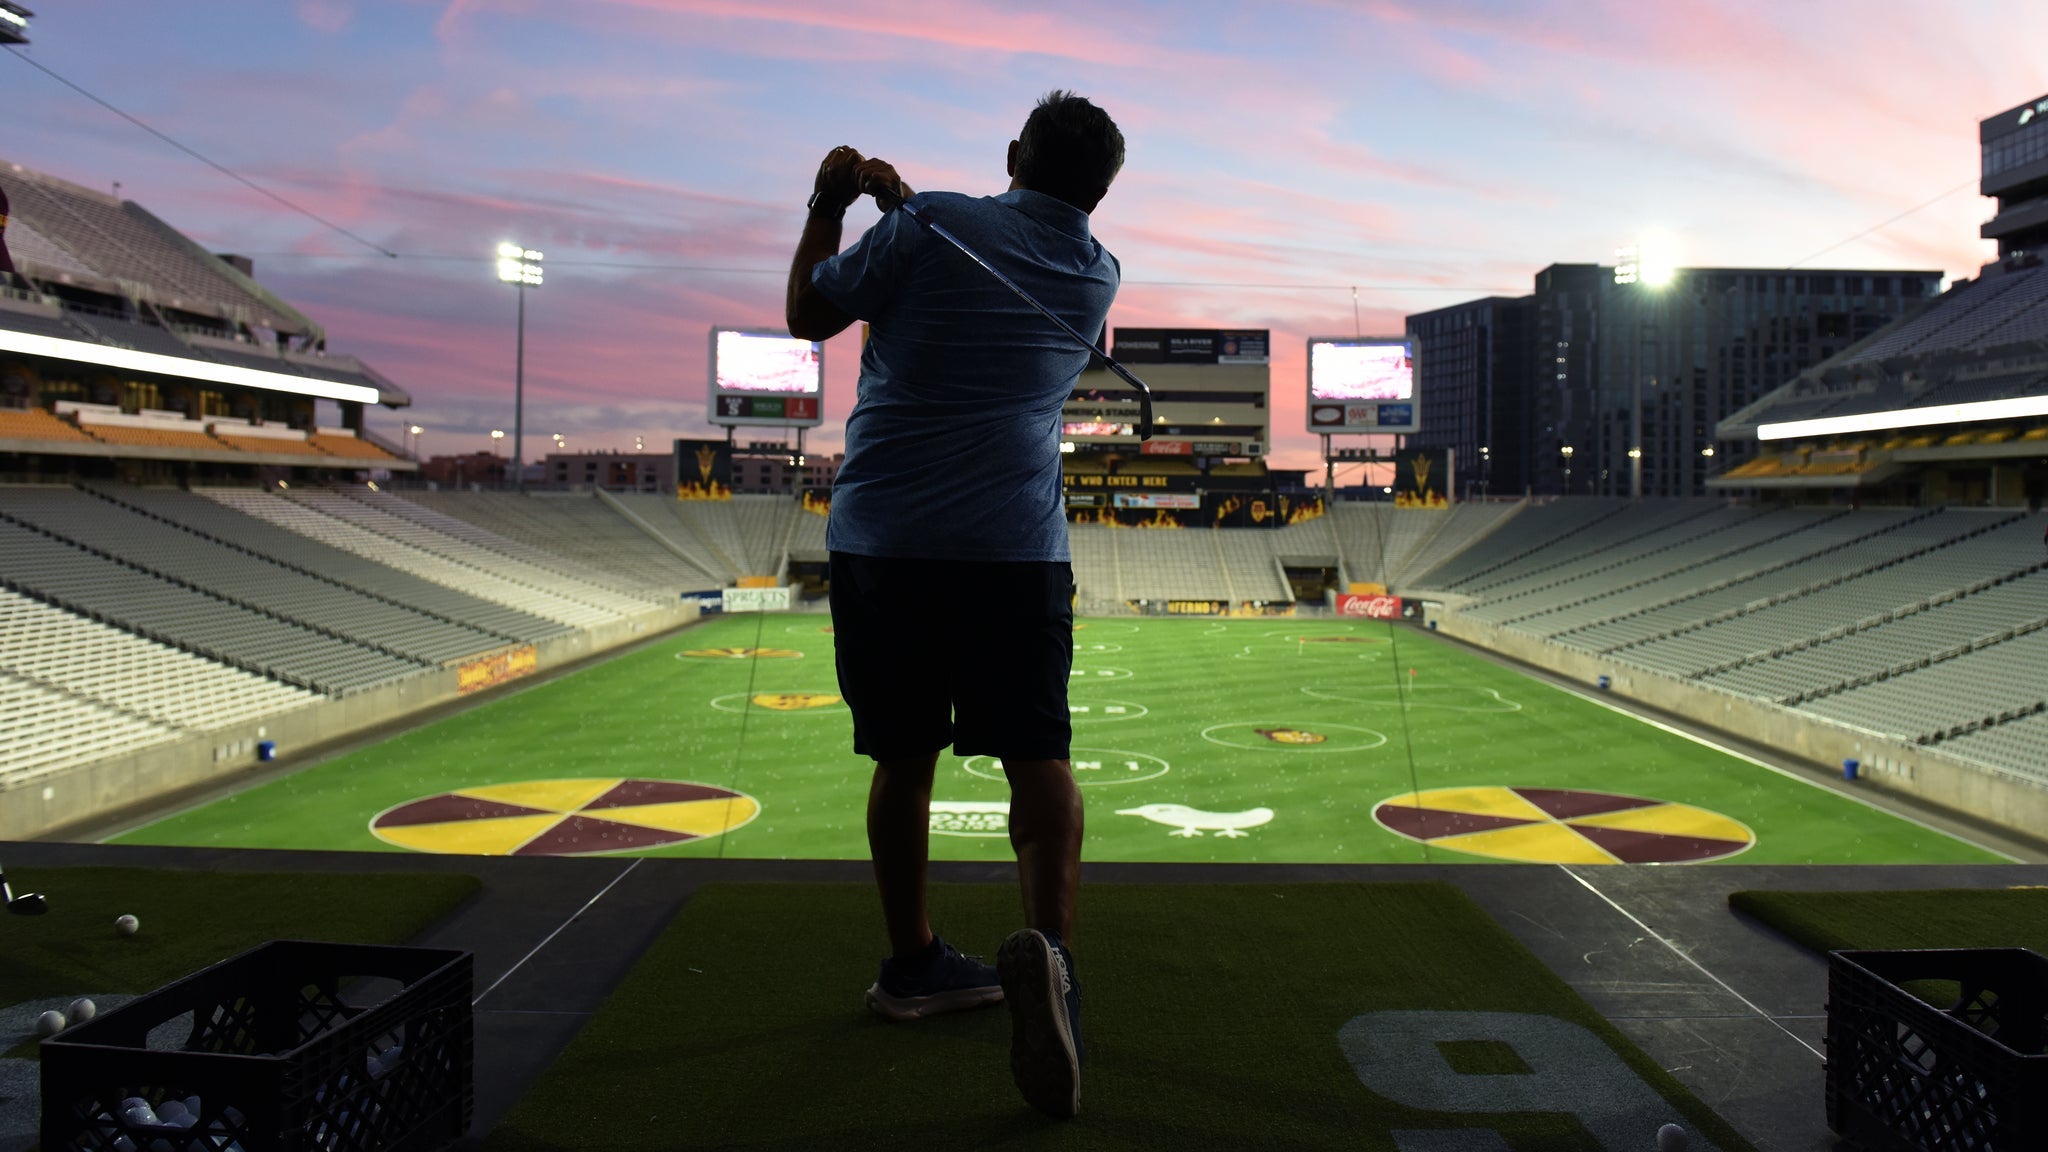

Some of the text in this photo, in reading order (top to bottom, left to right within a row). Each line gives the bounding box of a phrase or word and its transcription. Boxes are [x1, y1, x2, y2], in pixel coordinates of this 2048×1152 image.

[1104, 408, 1142, 416] STADIU
[1080, 475, 1103, 486] WHO
[1107, 476, 1138, 487] ENTER
[1142, 476, 1168, 487] HERE
[1050, 947, 1071, 994] HOKA
